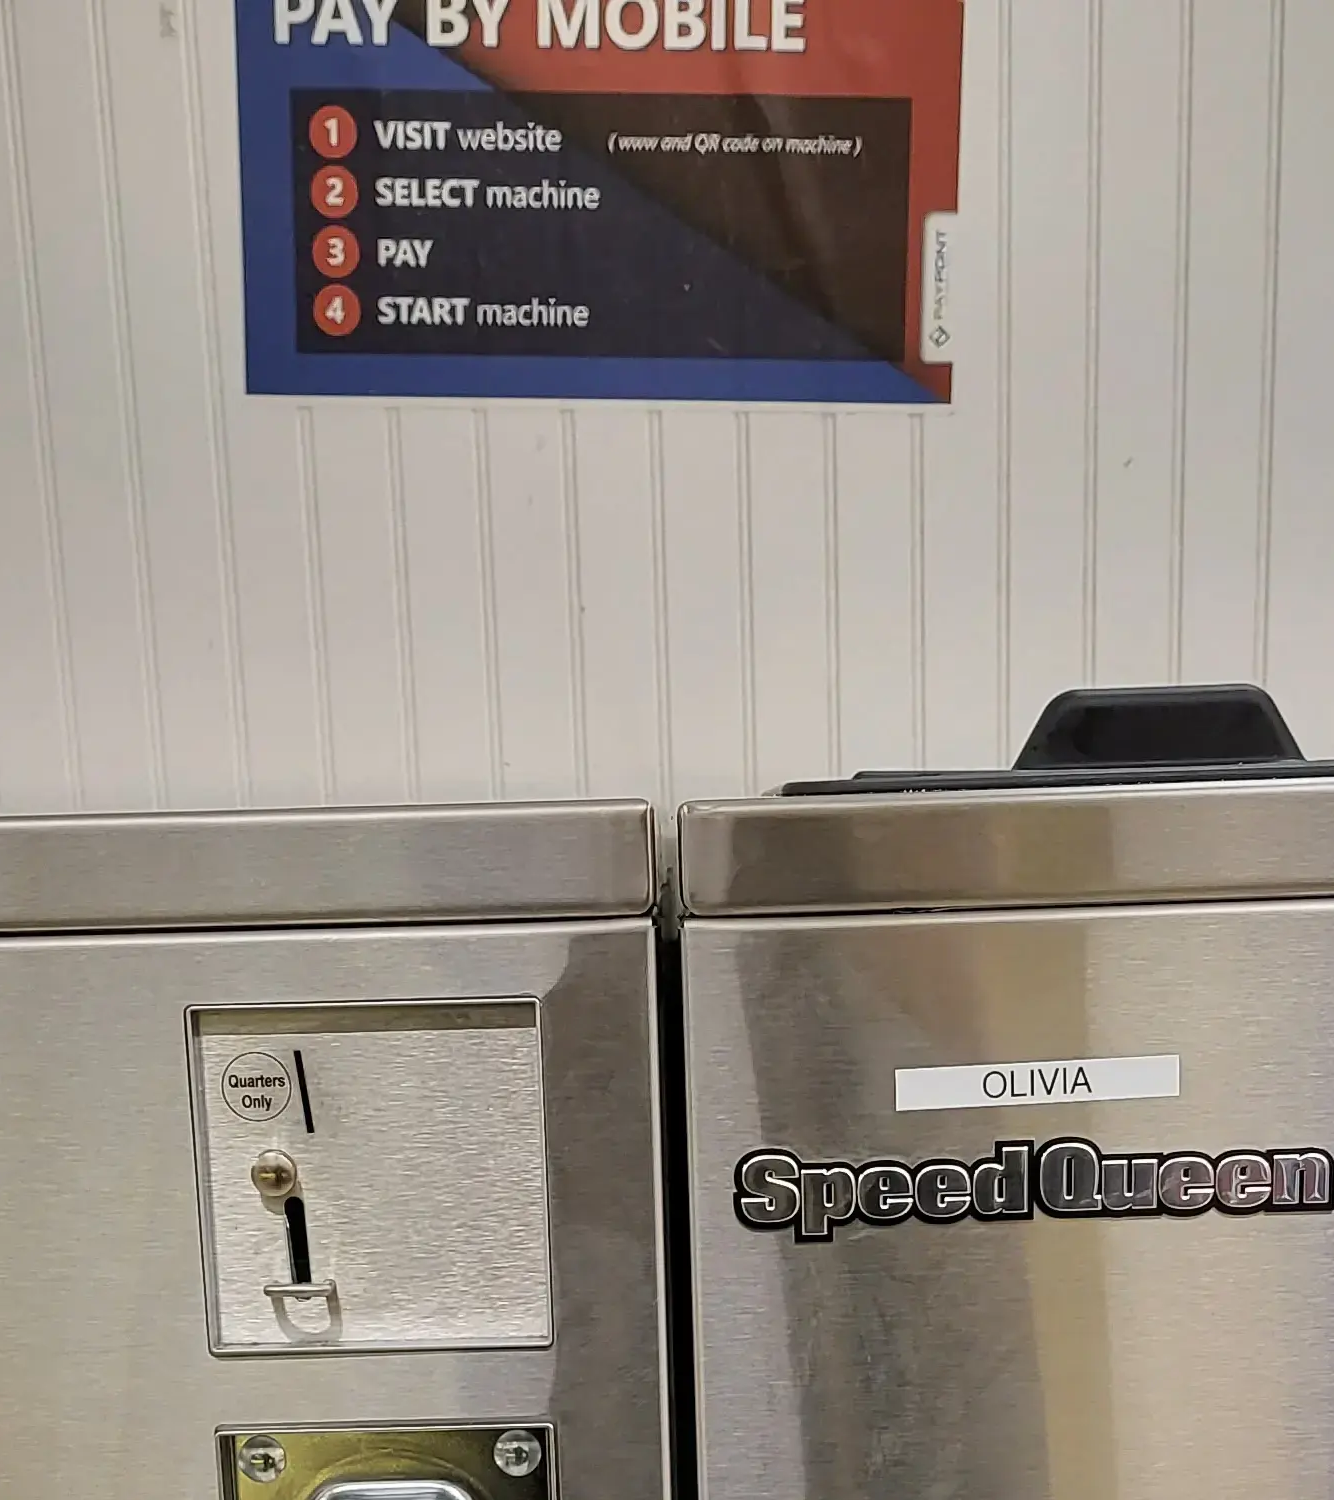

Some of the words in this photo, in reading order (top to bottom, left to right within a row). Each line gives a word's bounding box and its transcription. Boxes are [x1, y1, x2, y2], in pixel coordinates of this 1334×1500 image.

[273, 0, 395, 46] PAY
[425, 0, 504, 48] BY
[535, 0, 807, 53] MOBILE
[325, 119, 340, 147] 1
[373, 120, 452, 150] VISIT
[457, 121, 563, 153] website
[660, 132, 693, 152] and
[694, 133, 721, 155] QR
[722, 134, 760, 153] code
[761, 137, 784, 153] on
[325, 180, 344, 206] 2
[374, 179, 481, 208] SELECT
[486, 179, 601, 211] machine
[325, 239, 345, 266] 3
[376, 239, 433, 267] PAY
[325, 299, 345, 325] 4
[376, 298, 471, 326] START
[476, 298, 590, 329] machine
[228, 1074, 286, 1088] Quarters
[982, 1067, 1093, 1099] OLIVIA
[241, 1095, 272, 1111] Only
